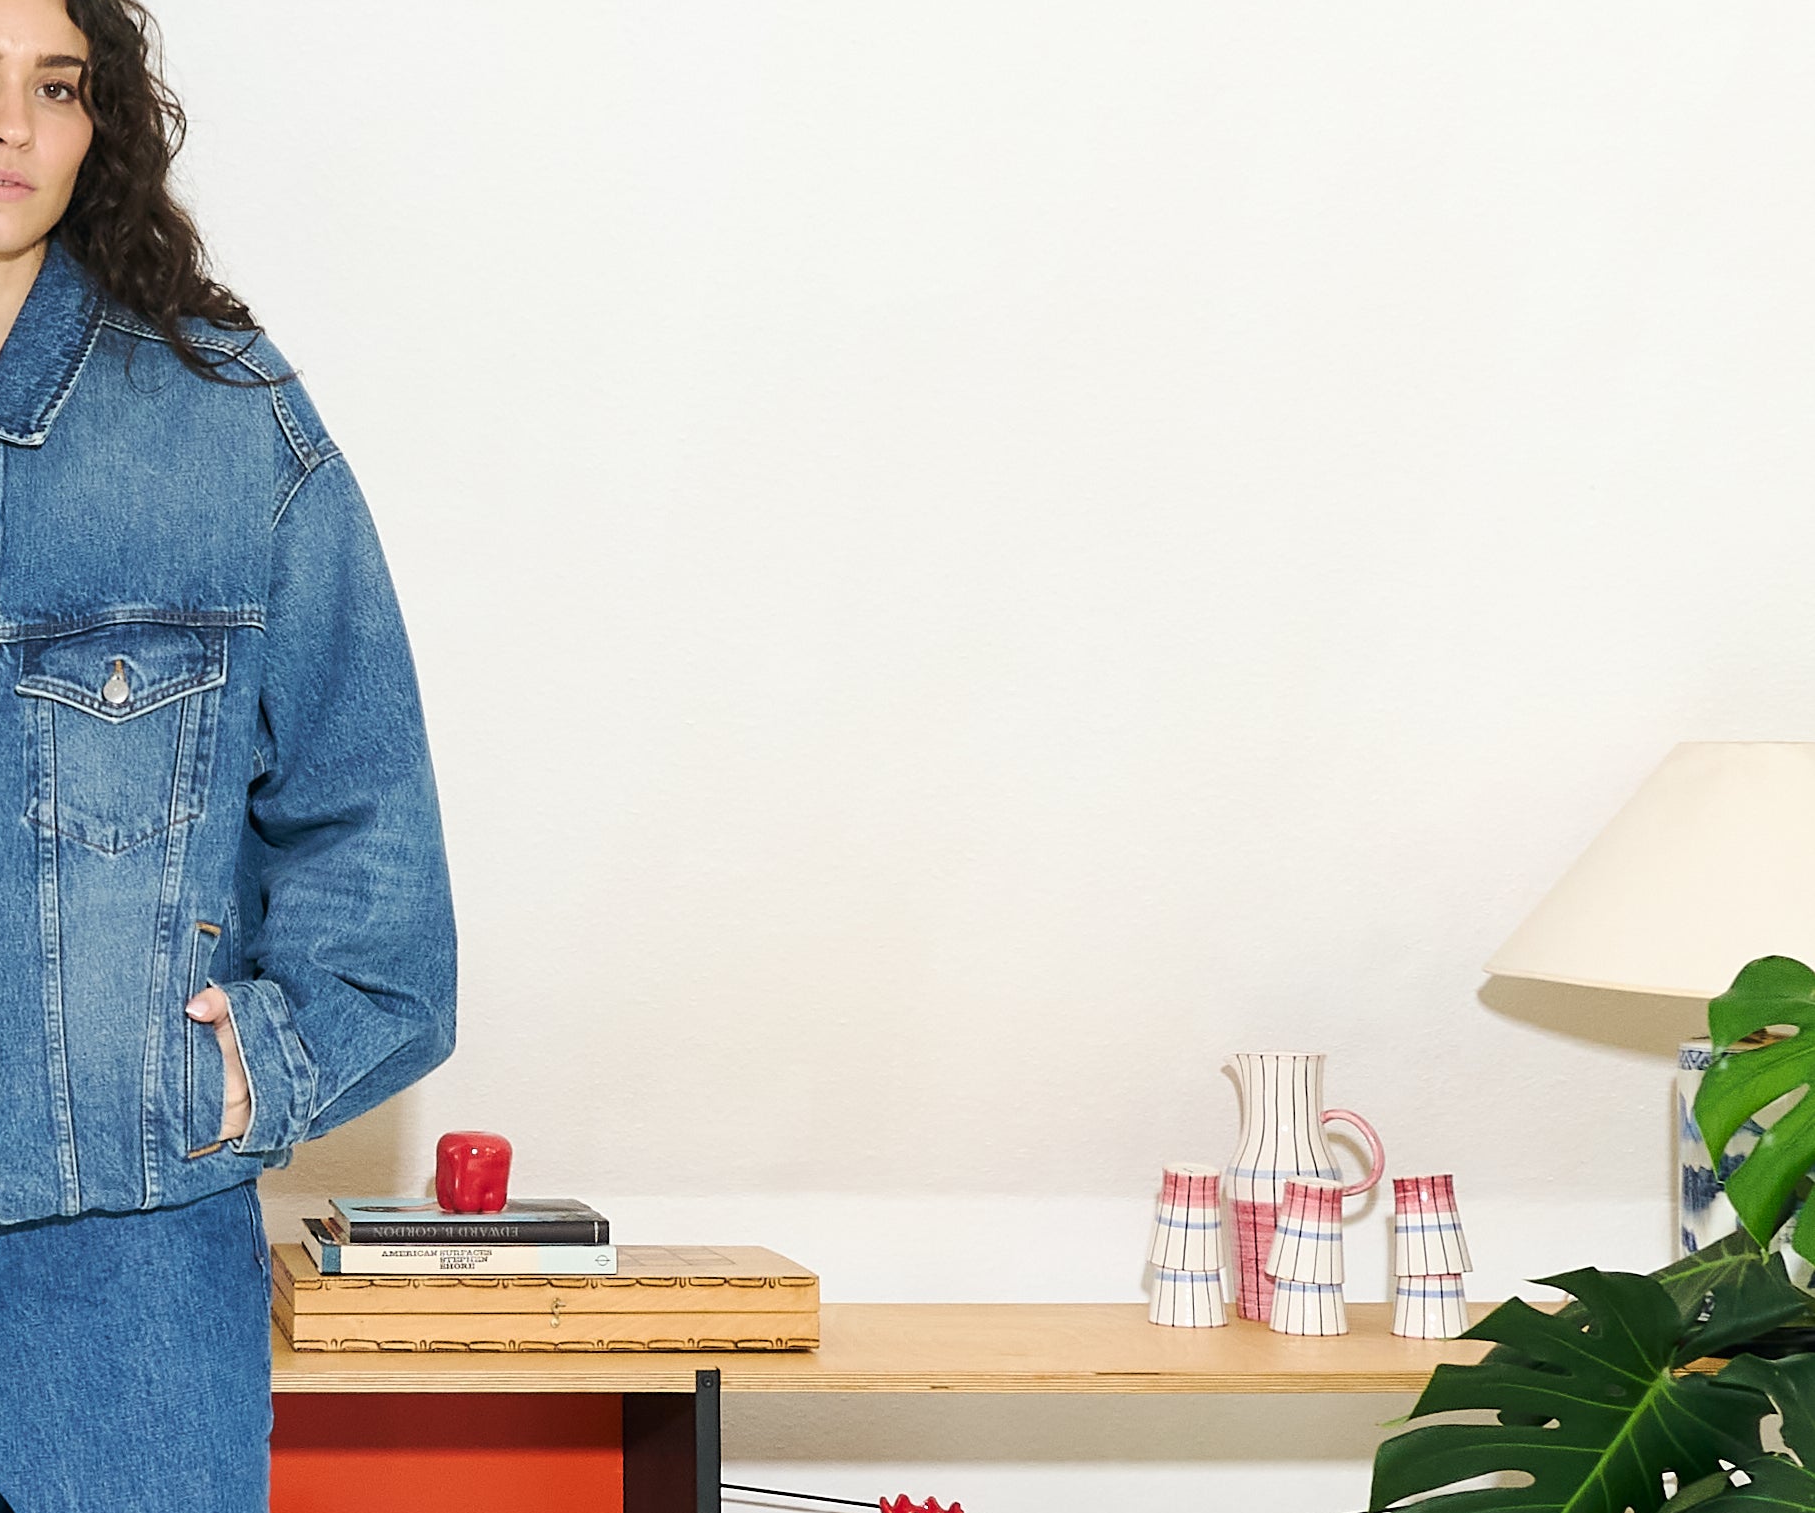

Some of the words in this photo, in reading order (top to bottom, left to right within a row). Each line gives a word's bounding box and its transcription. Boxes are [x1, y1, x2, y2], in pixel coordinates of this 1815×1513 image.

[373, 1226, 437, 1237] GORDON
[442, 1226, 453, 1237] B.
[458, 1226, 519, 1237] EDWARD
[439, 1249, 493, 1257] SURFACES
[439, 1262, 475, 1270] SHORE
